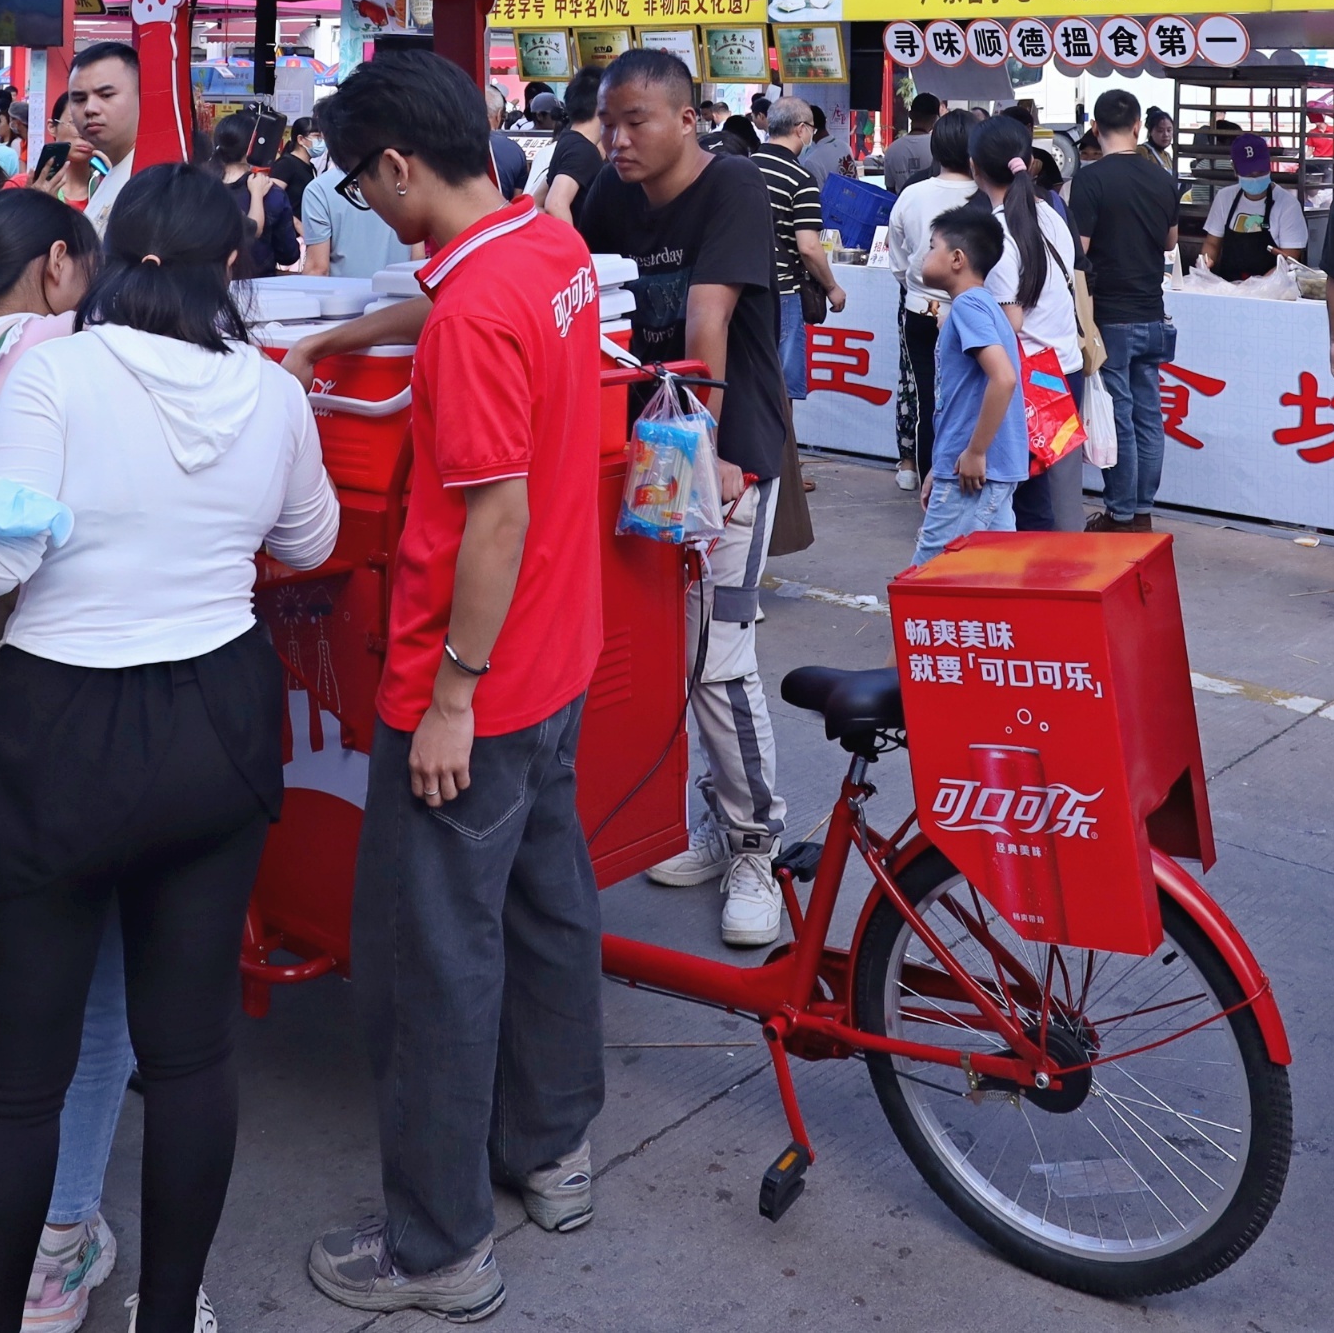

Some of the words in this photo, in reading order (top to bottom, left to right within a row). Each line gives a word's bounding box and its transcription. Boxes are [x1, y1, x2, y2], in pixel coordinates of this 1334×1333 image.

[1244, 146, 1255, 159] B
[551, 257, 597, 339] 可口可乐
[904, 618, 1015, 650] 畅爽美味
[932, 777, 1105, 839] 可口可乐
[995, 841, 1042, 858] 经典美味
